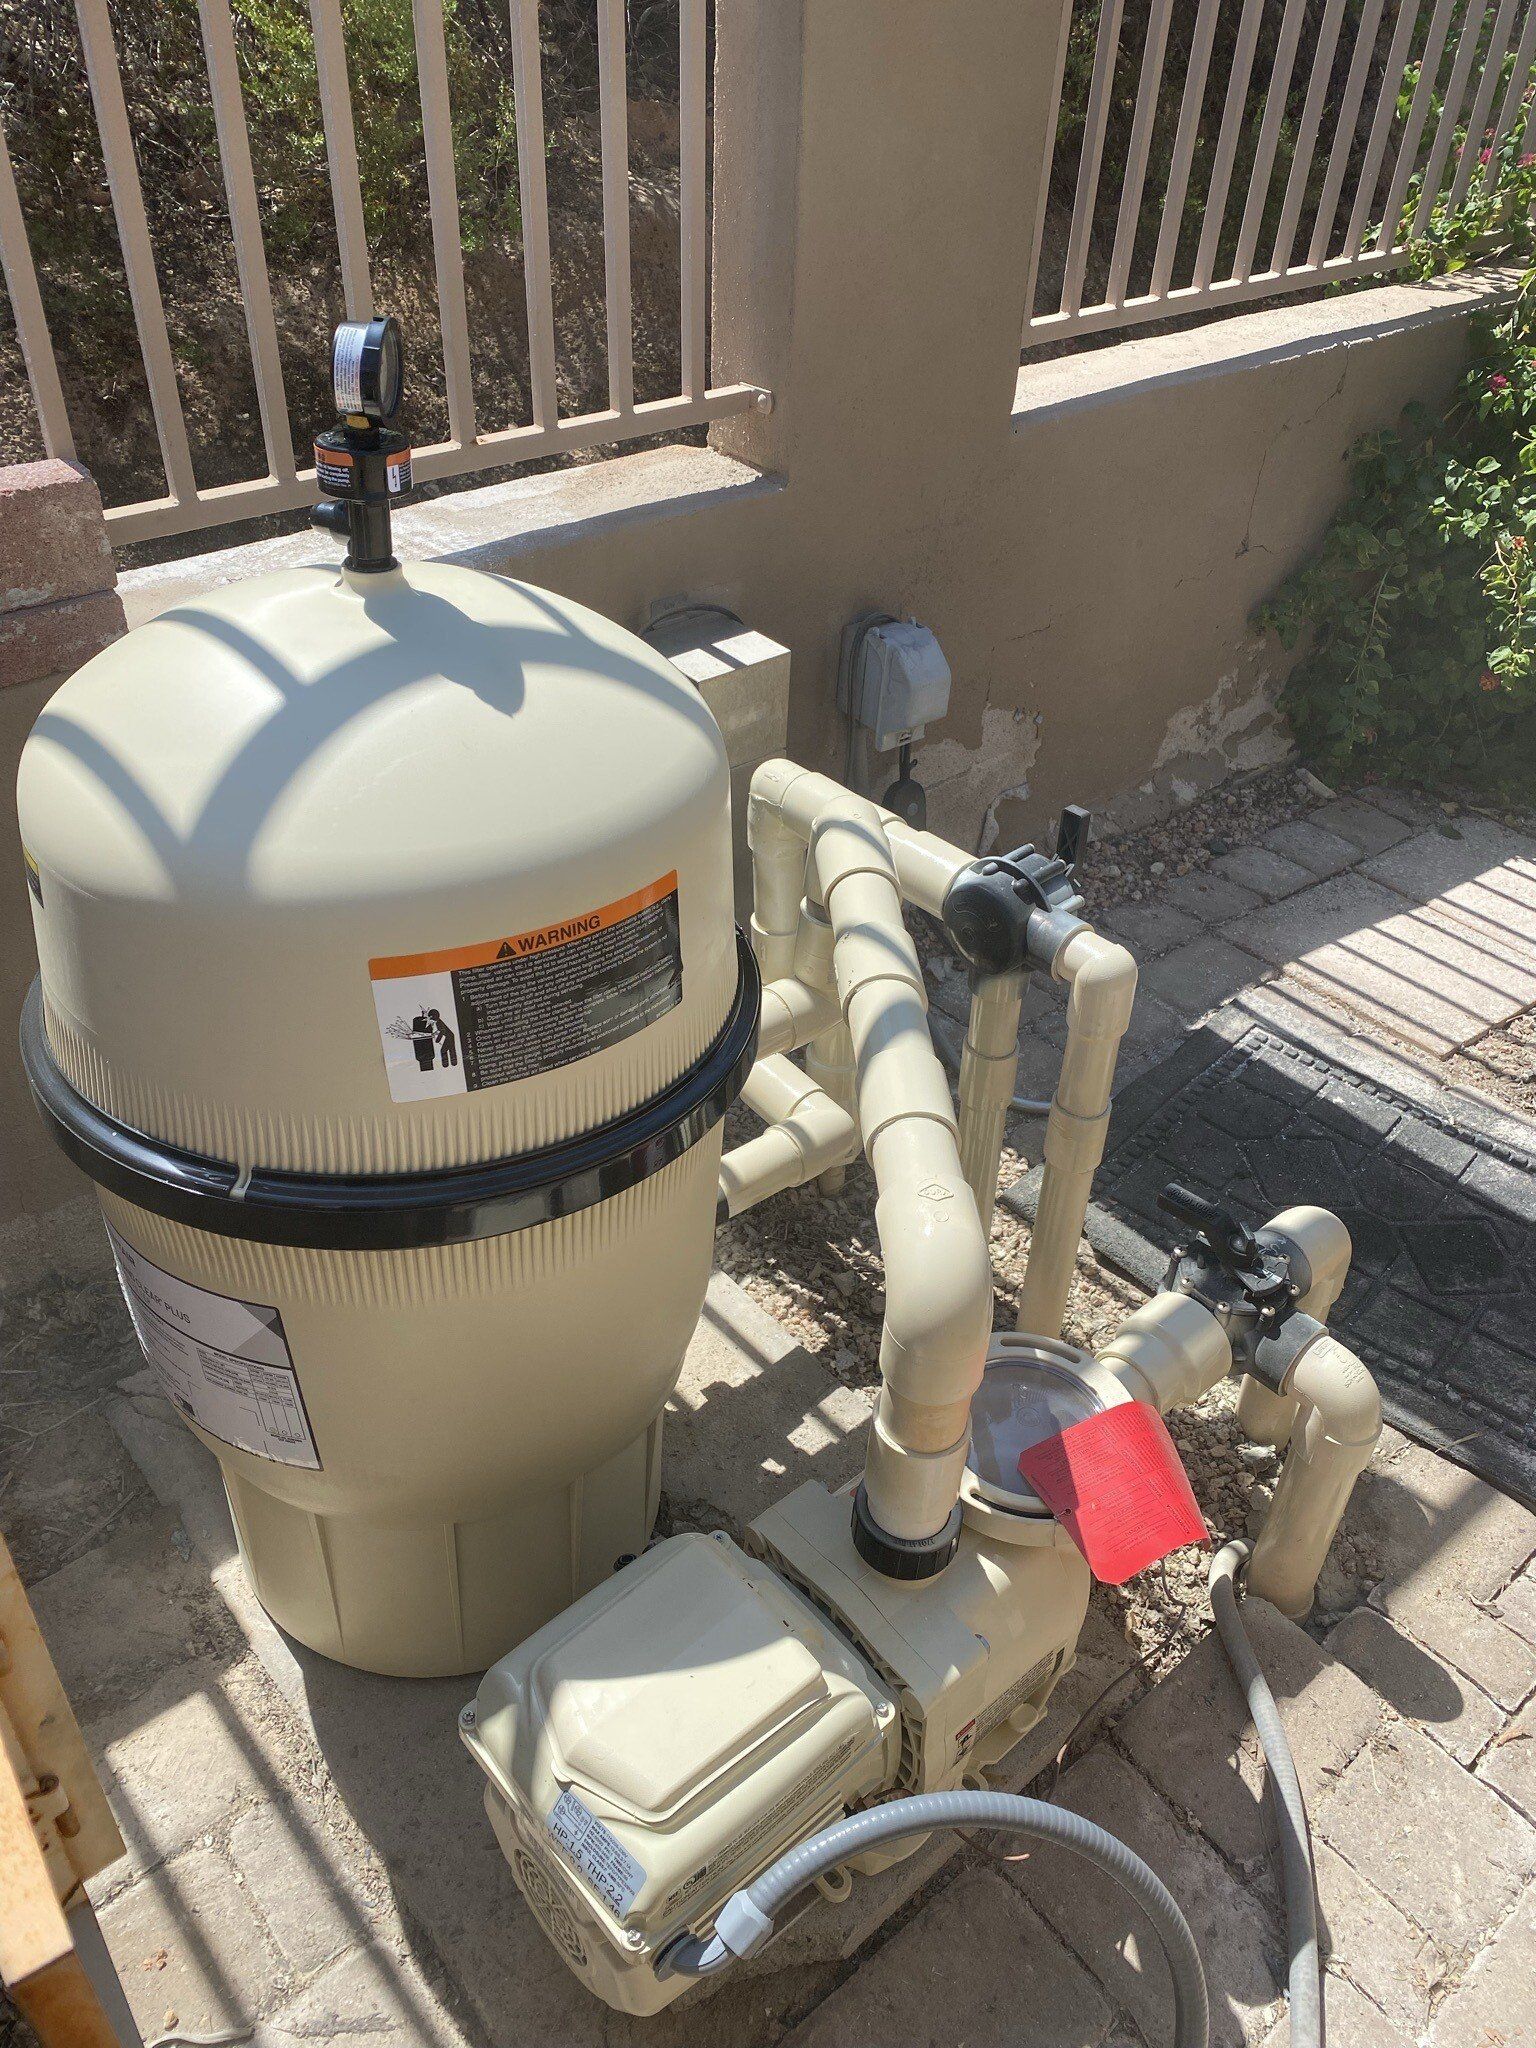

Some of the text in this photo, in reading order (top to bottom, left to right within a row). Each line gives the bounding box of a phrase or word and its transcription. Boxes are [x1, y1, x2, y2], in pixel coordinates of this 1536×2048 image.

[517, 914, 601, 952] WARNING
[163, 1301, 190, 1324] PLUS
[553, 1822, 583, 1859] HP:1.5
[586, 1859, 623, 1903] THP:2.2
